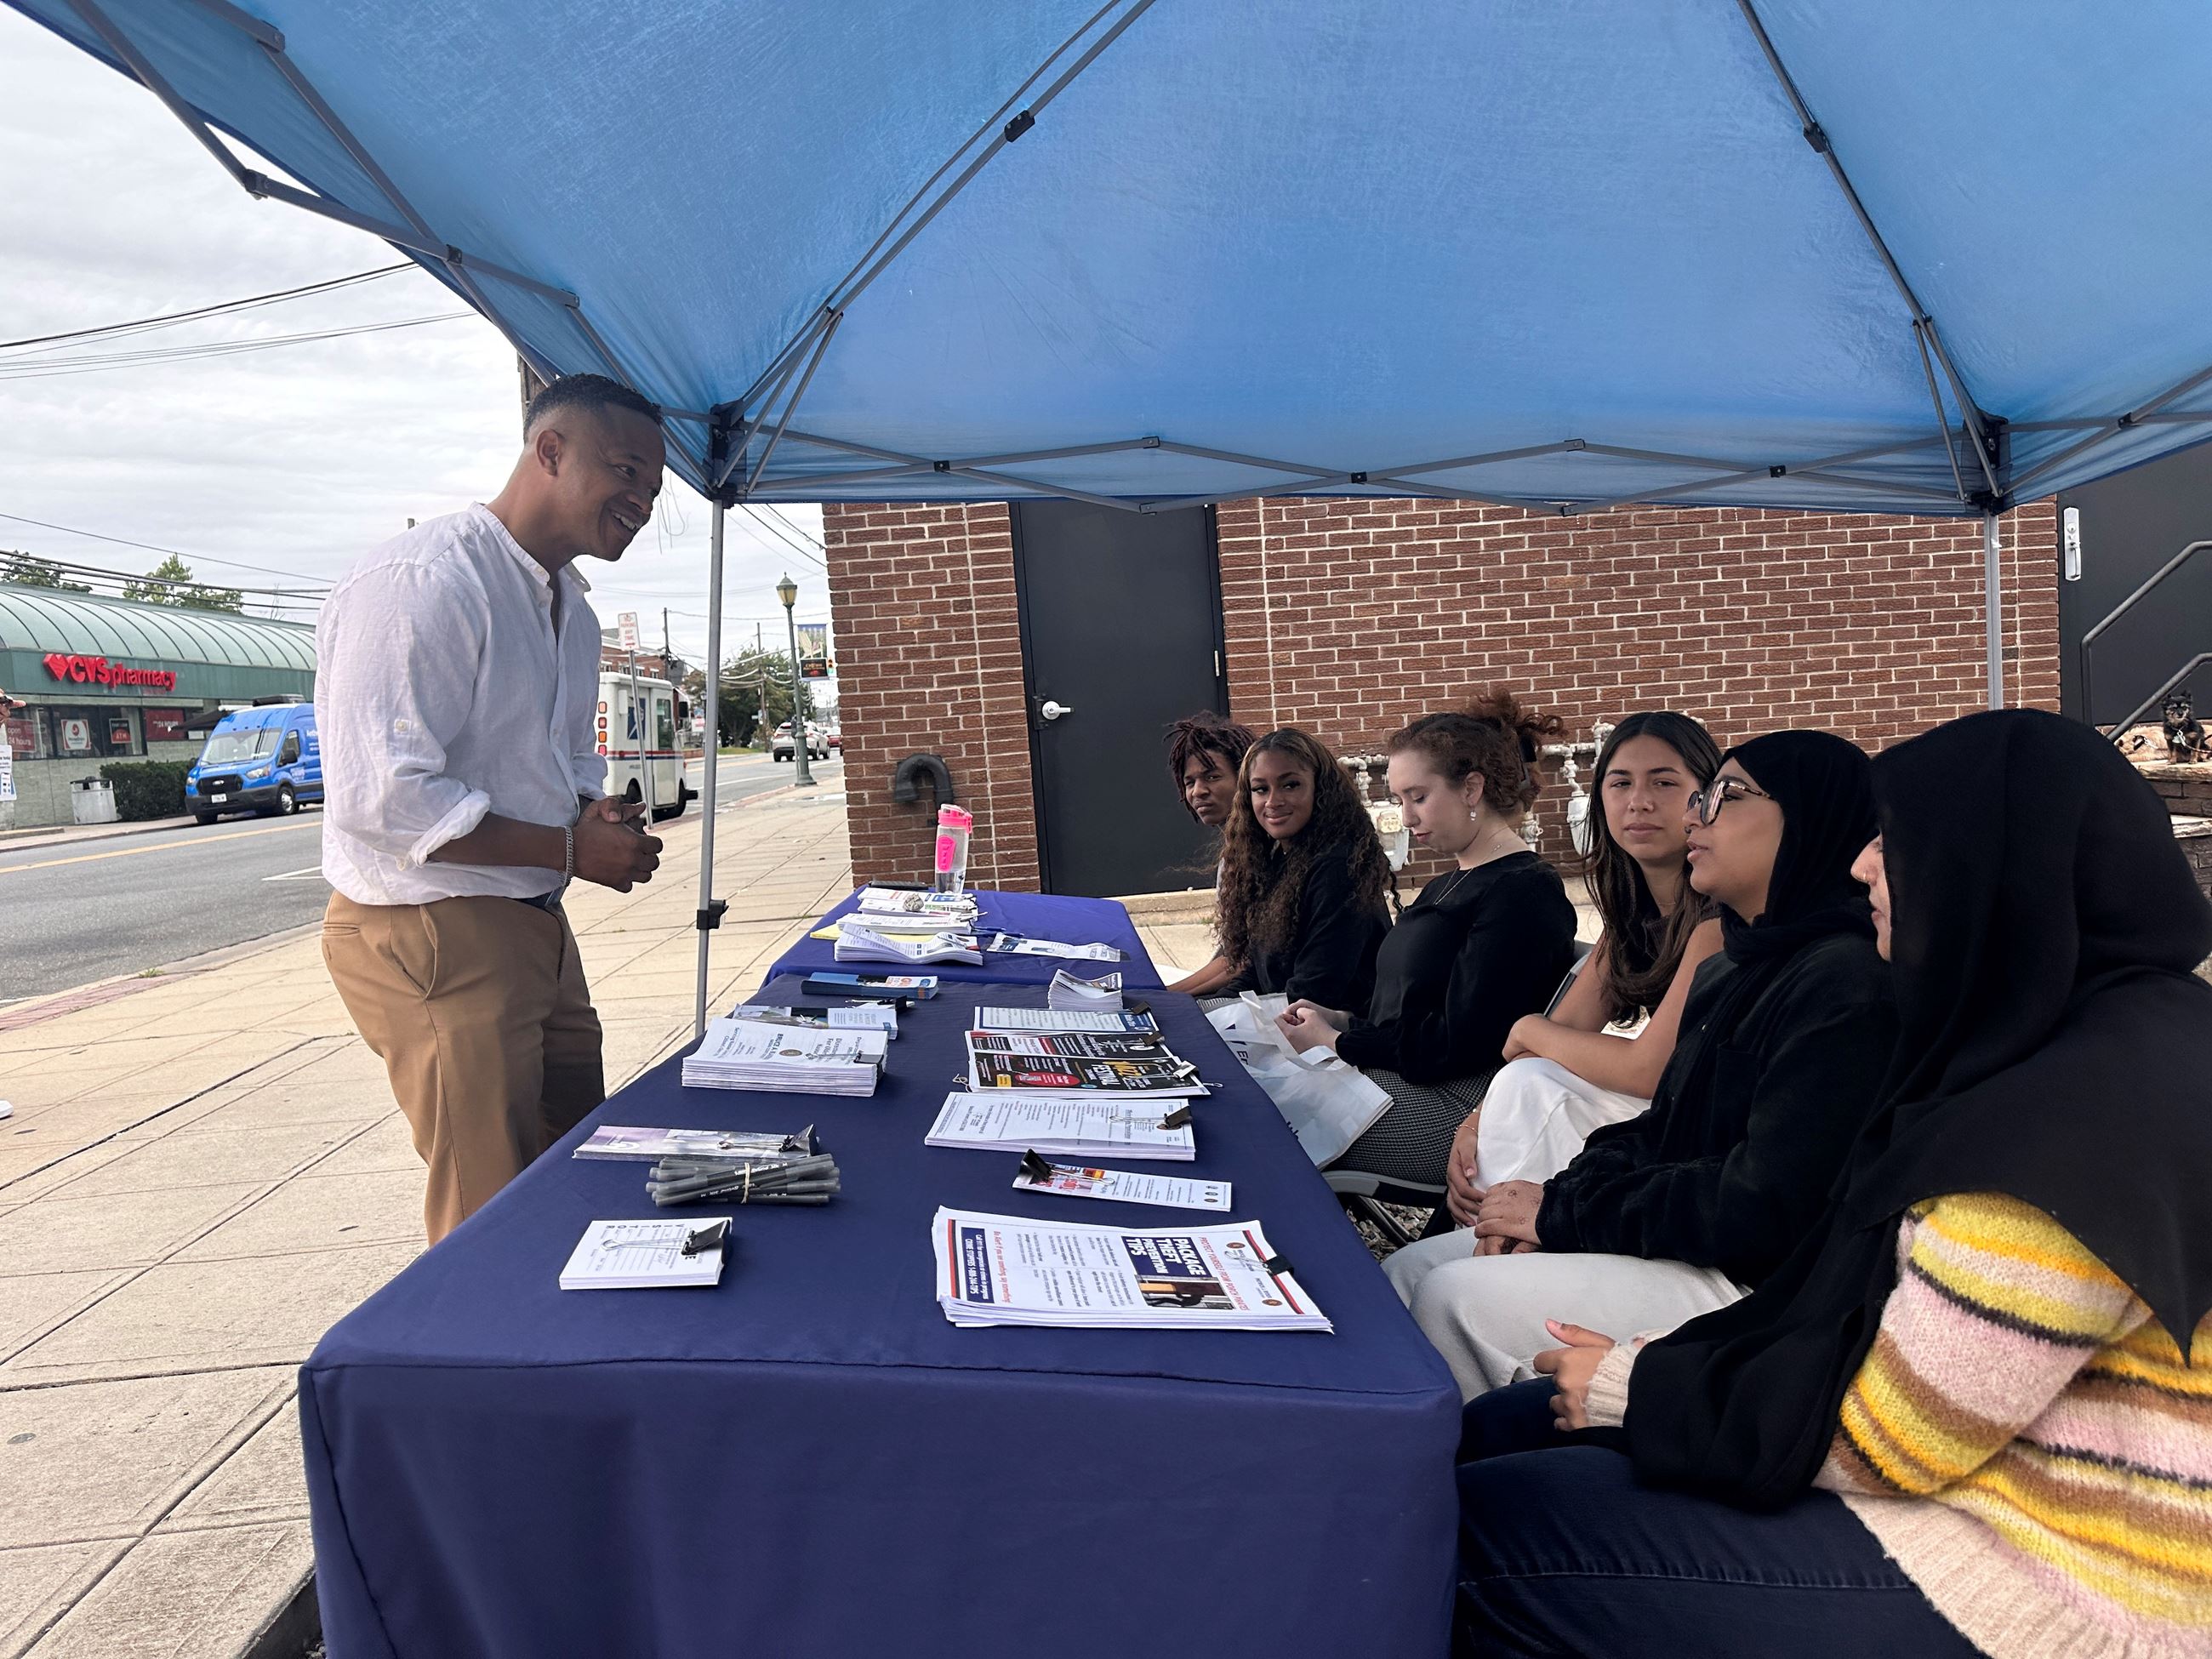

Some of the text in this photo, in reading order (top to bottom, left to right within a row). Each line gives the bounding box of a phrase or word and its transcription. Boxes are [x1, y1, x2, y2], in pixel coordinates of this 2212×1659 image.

[1126, 1238, 1147, 1255] TIPS
[1142, 1238, 1169, 1274] PREVENTION
[1156, 1238, 1183, 1263] THEFT
[1172, 1238, 1206, 1275] PACKAGE
